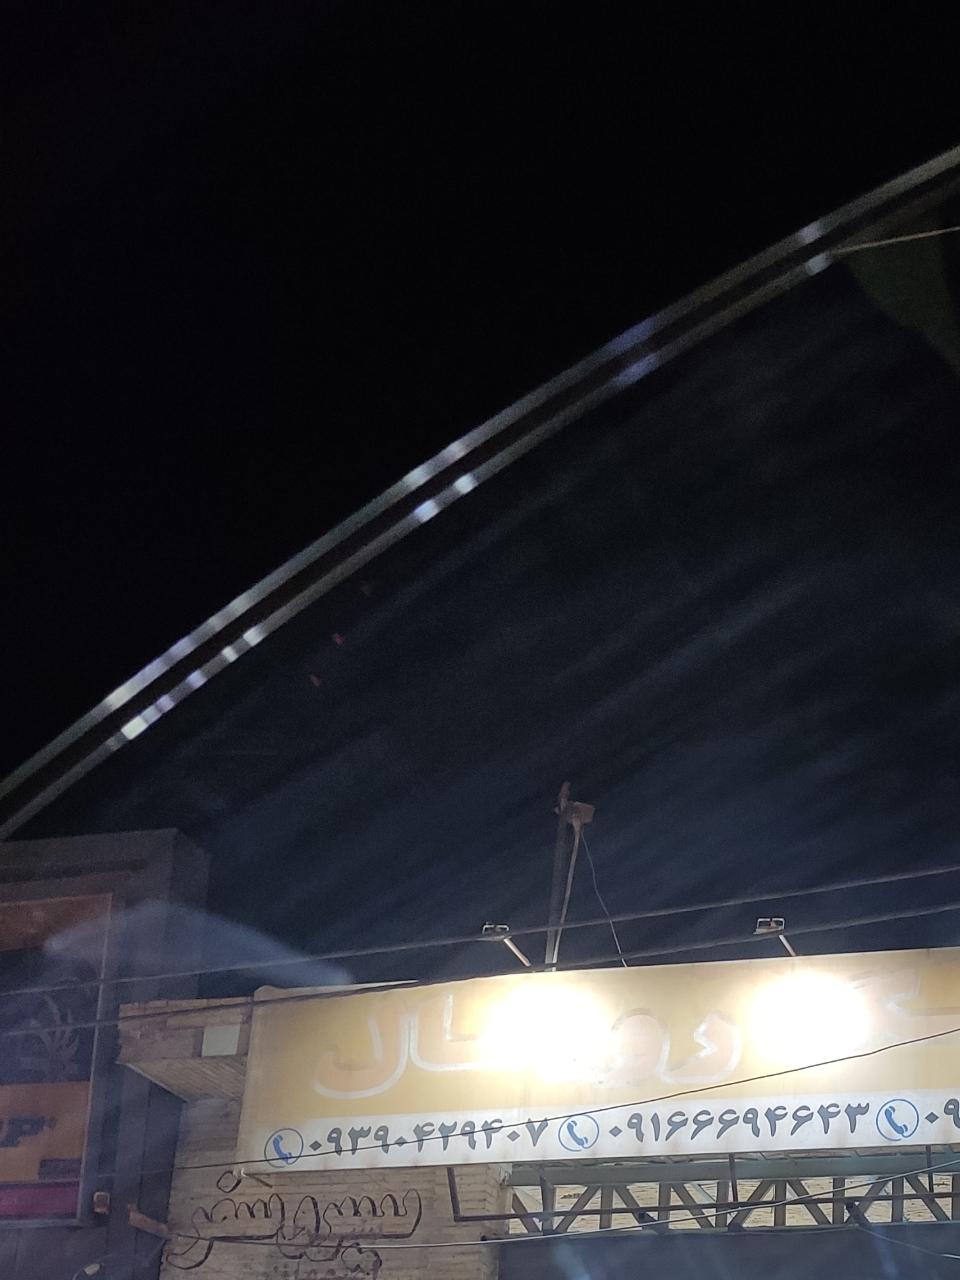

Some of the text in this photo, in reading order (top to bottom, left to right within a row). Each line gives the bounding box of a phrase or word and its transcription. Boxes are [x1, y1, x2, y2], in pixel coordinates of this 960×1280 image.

[311, 992, 743, 1101] روال
[308, 1117, 550, 1157] ۰۹۳۹۰۴۲۹۴۰۷
[608, 1102, 870, 1143] ۰۹۱۶۶۶۹۴۶۴۳
